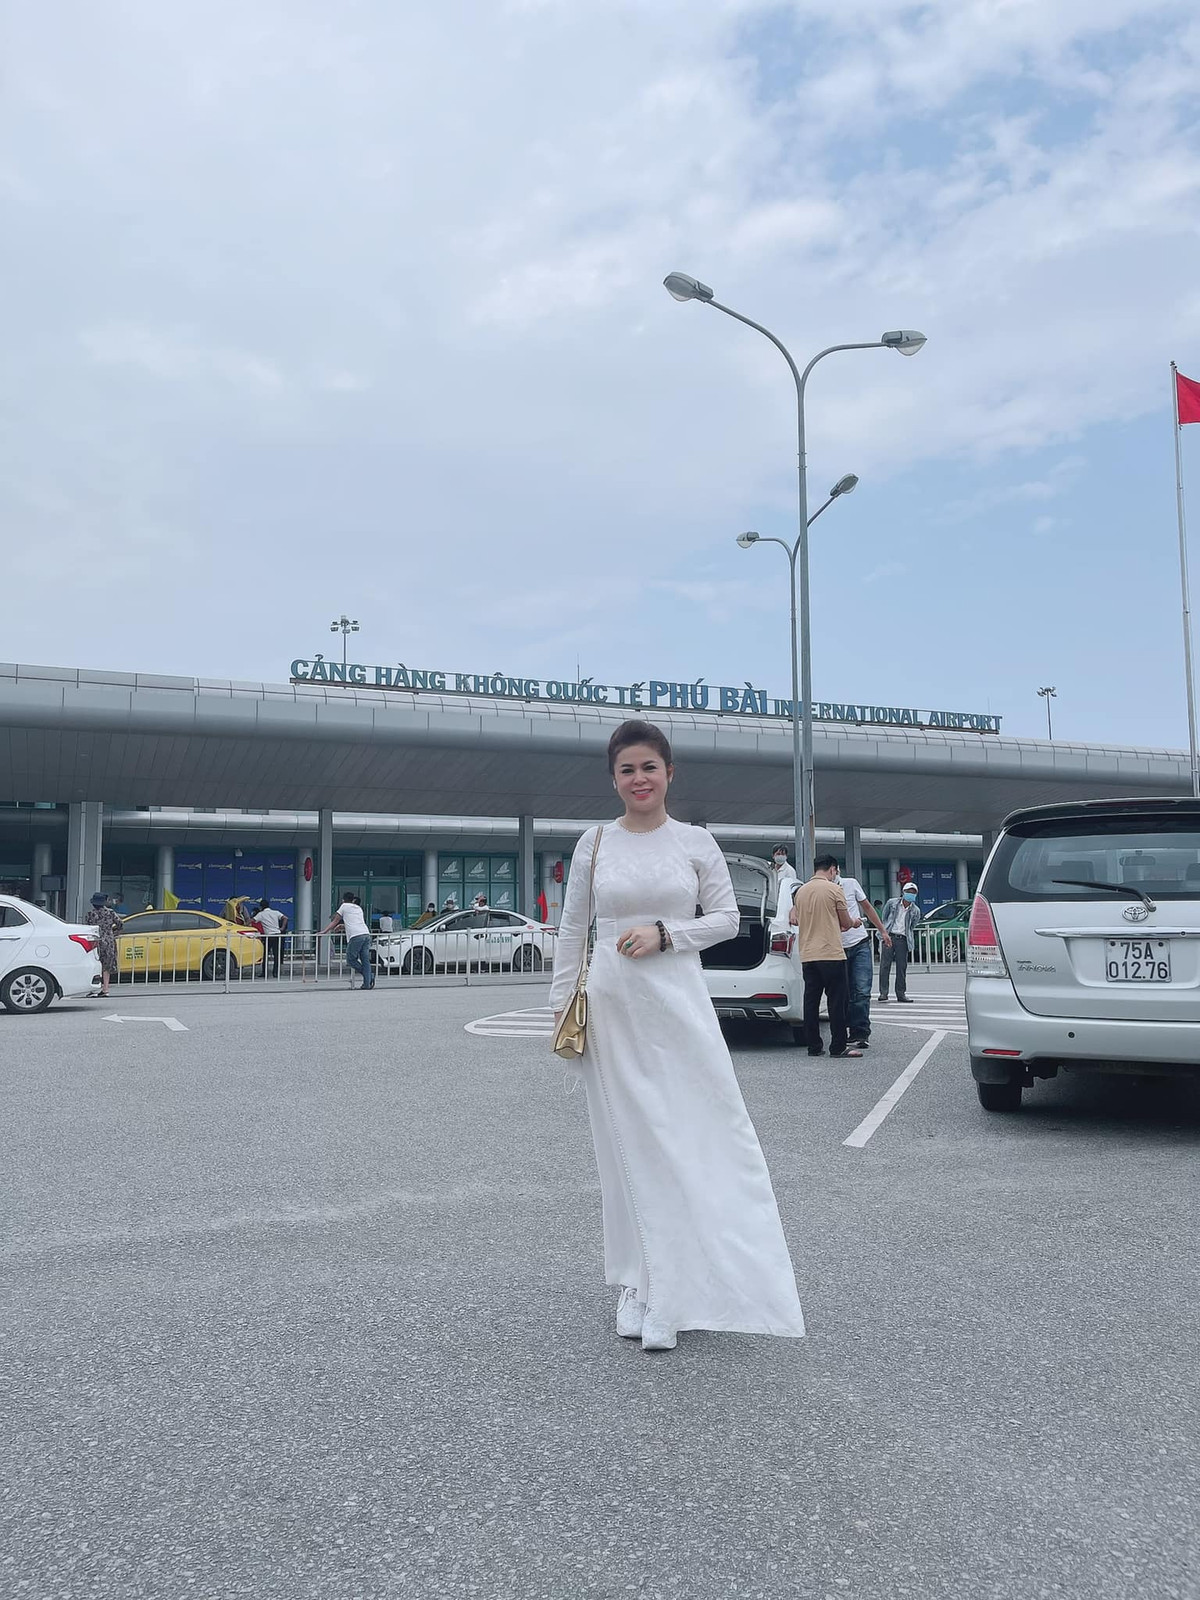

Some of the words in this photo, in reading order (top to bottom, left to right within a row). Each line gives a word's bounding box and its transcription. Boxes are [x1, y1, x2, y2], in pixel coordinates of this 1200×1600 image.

[290, 654, 367, 684] CẢNG
[375, 663, 446, 691] HÀNG
[455, 672, 540, 699] KHÔNG
[546, 677, 608, 703] QUỐC
[615, 682, 646, 706] TẾ
[649, 678, 709, 710] PHÚ
[720, 682, 767, 715] BÀI
[928, 711, 1002, 731] AIRPORT
[1120, 942, 1154, 959] 75A
[1109, 961, 1168, 979] 012.76
